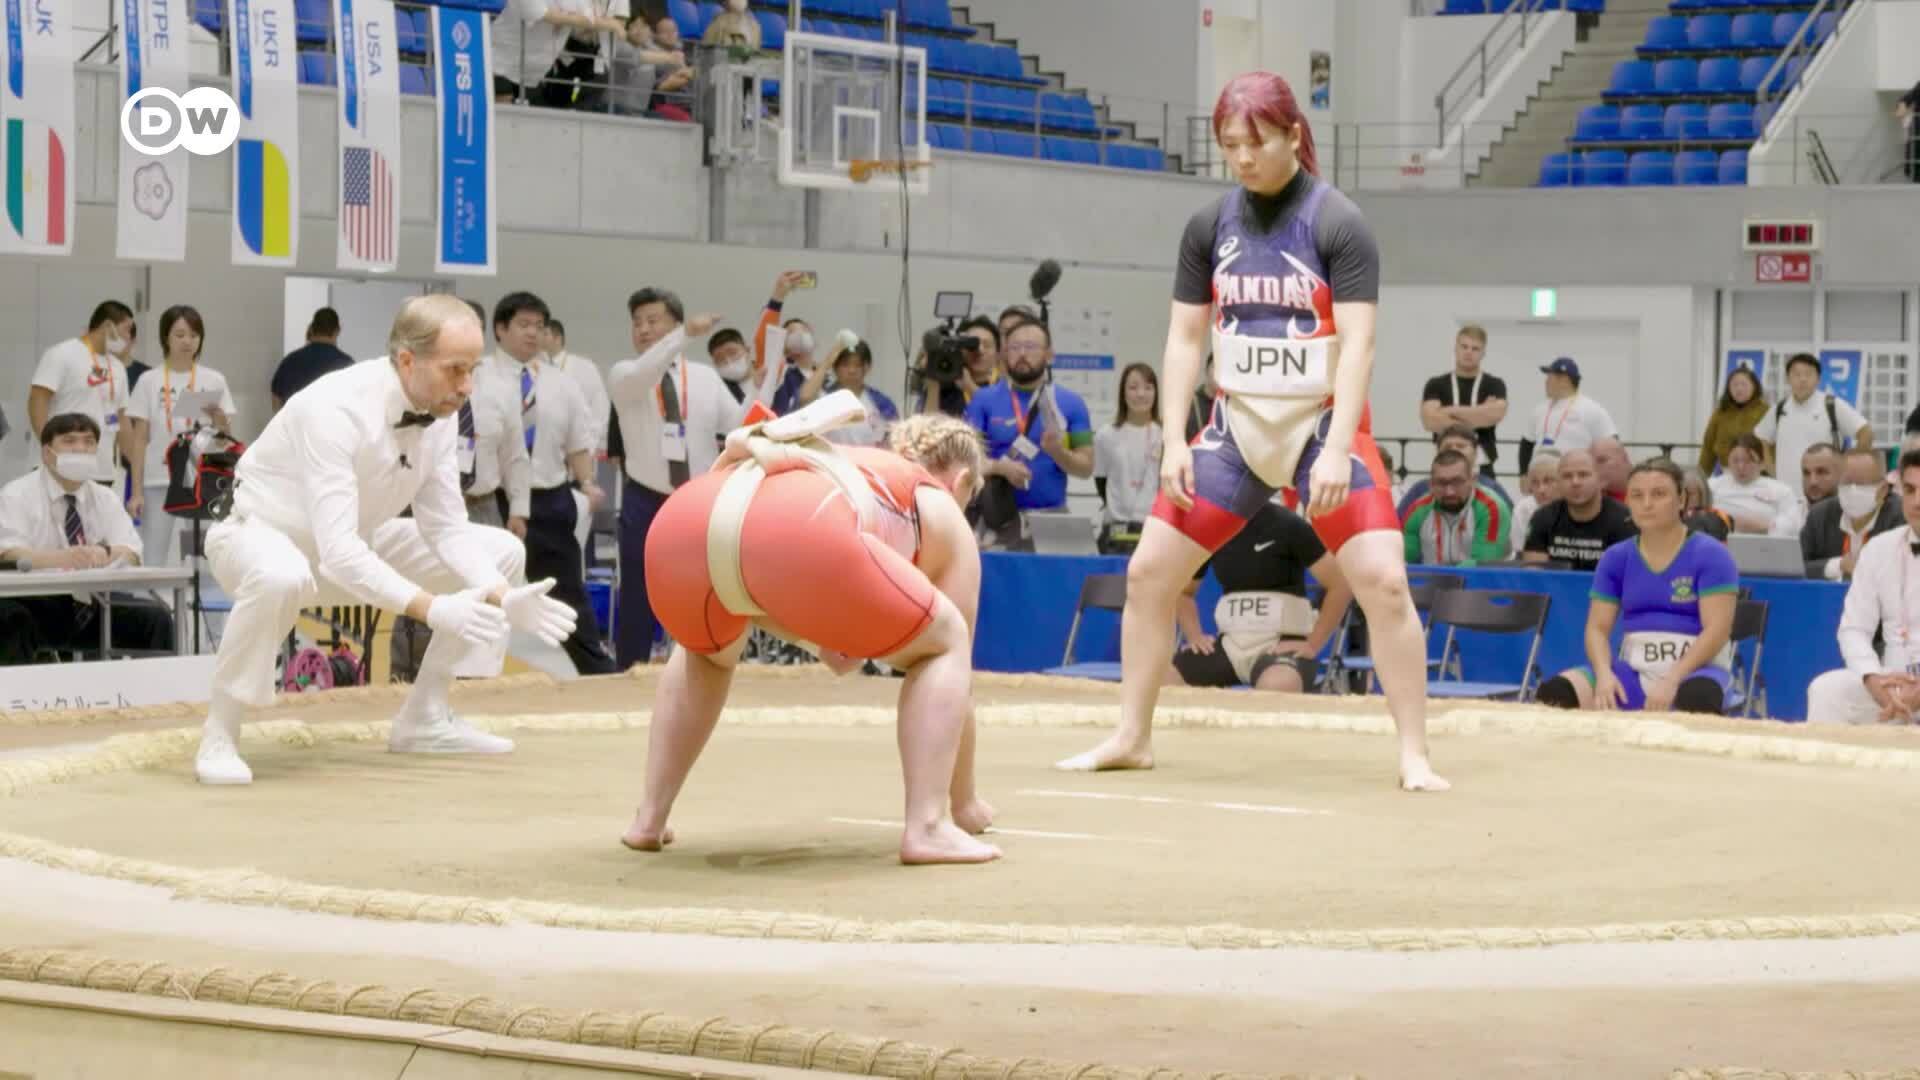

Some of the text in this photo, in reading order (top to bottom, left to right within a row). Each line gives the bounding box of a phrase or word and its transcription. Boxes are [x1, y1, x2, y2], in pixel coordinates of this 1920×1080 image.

[262, 9, 279, 68] UKR
[365, 20, 382, 77] USA
[454, 52, 472, 91] IFS
[1235, 345, 1307, 376] JPN
[1227, 597, 1271, 617] TPE
[1643, 641, 1691, 662] BRA
